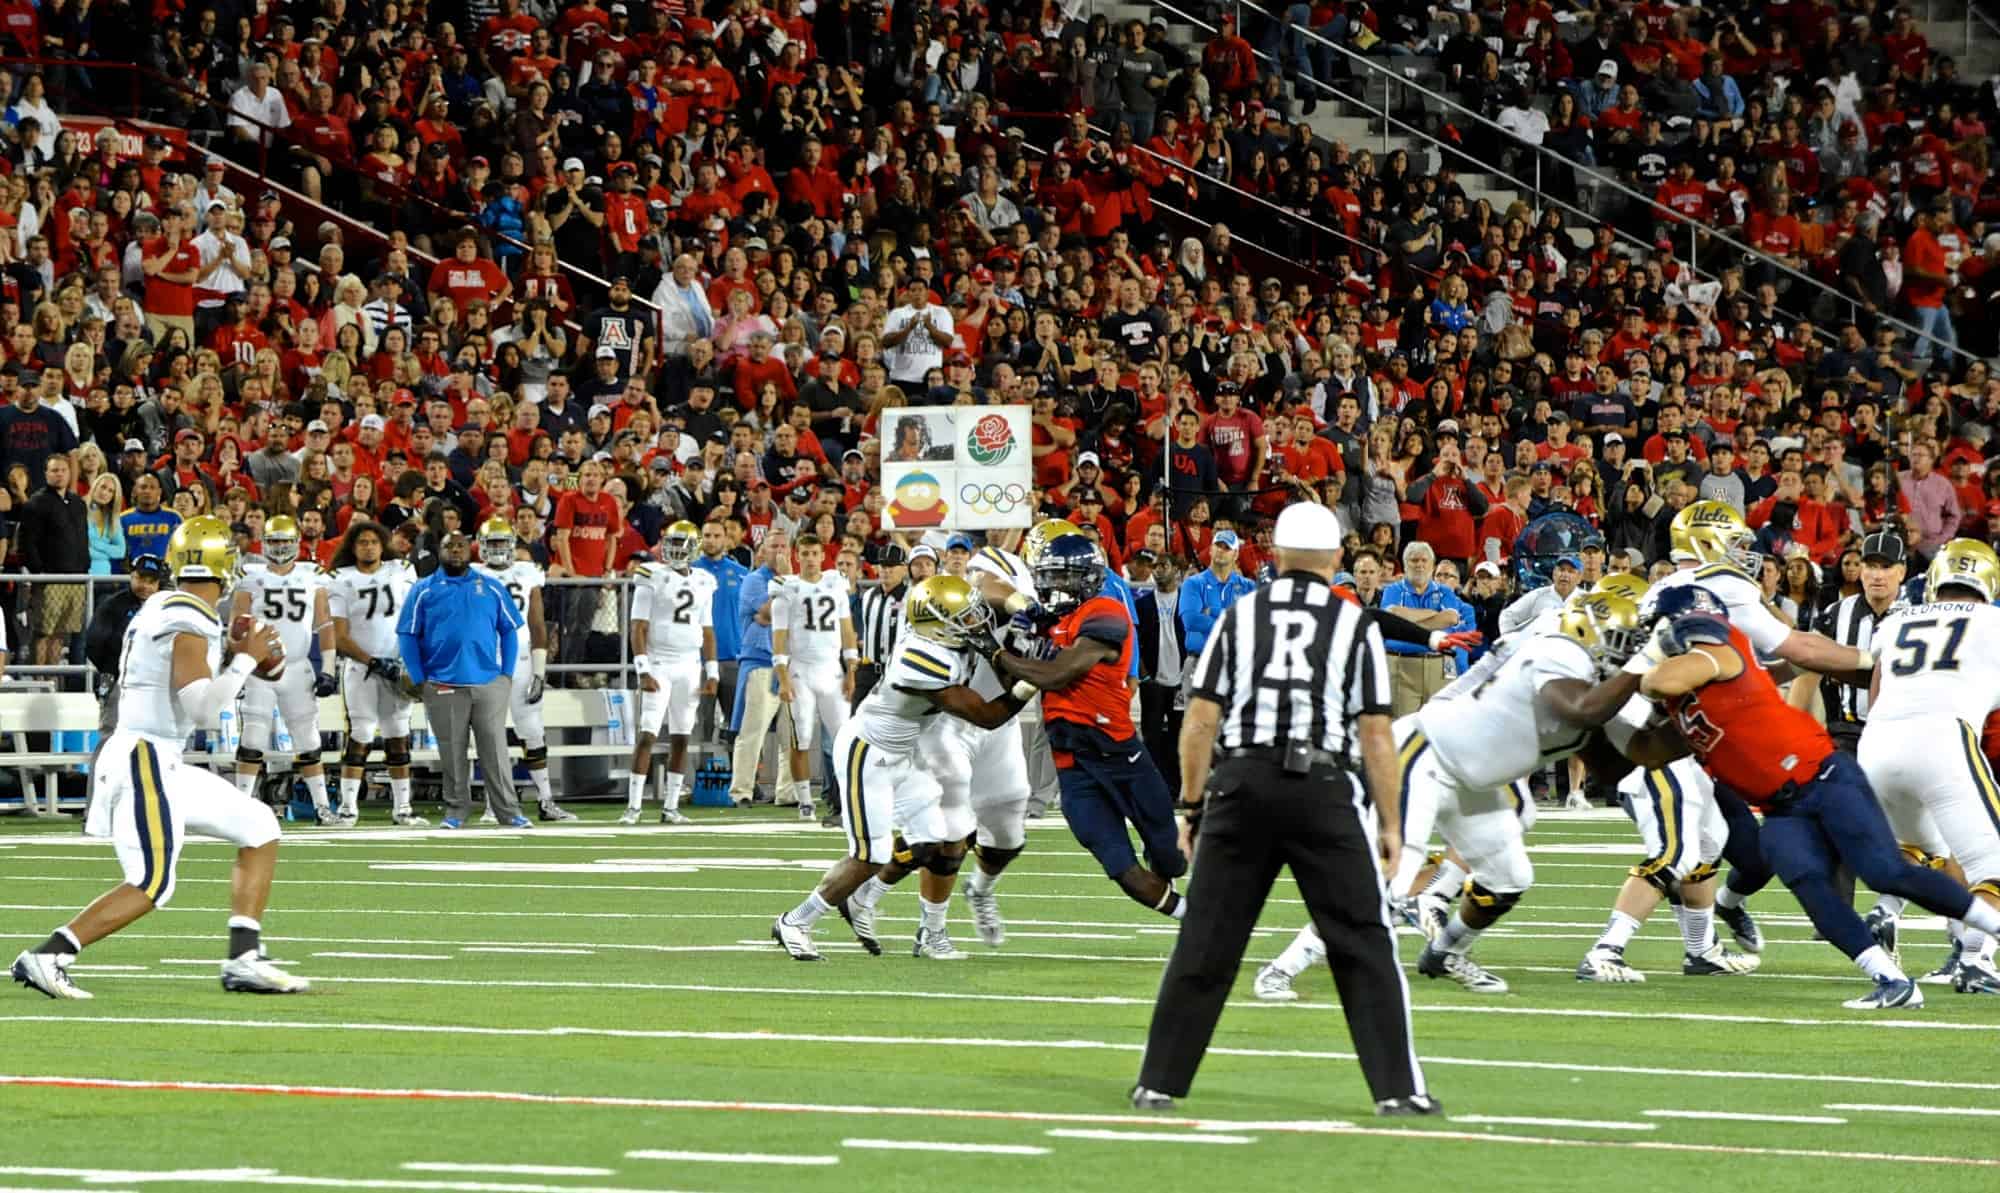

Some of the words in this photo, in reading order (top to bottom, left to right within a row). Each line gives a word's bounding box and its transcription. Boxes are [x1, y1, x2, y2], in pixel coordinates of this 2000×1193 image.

[600, 316, 632, 350] A
[232, 341, 255, 365] 10
[1174, 452, 1198, 477] UA
[1439, 487, 1465, 510] A
[128, 523, 169, 536] UCLA
[572, 526, 608, 541] DOWN
[187, 549, 204, 566] 17
[1957, 556, 1977, 575] 51
[263, 587, 307, 623] 55
[357, 584, 395, 621] 71
[673, 589, 695, 625] 2
[801, 595, 837, 632] 12
[1901, 602, 1976, 617] REDMOND
[1262, 609, 1319, 681] R
[1891, 616, 1971, 676] 51
